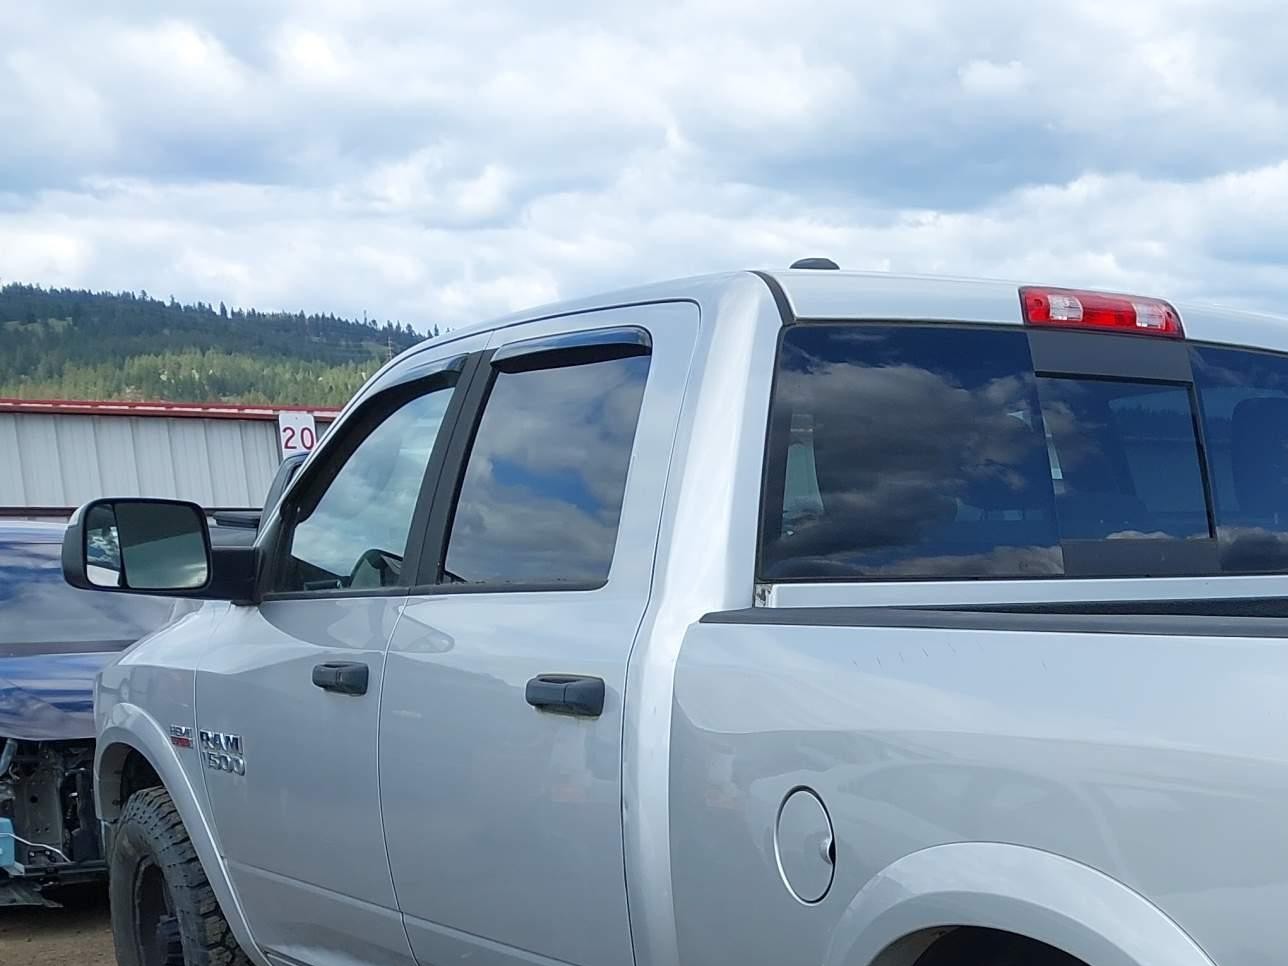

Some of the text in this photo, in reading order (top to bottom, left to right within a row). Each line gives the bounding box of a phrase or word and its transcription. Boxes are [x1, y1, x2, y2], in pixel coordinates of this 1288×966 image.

[282, 426, 315, 451] 20
[200, 729, 244, 755] RAM
[202, 751, 246, 776] 1500
